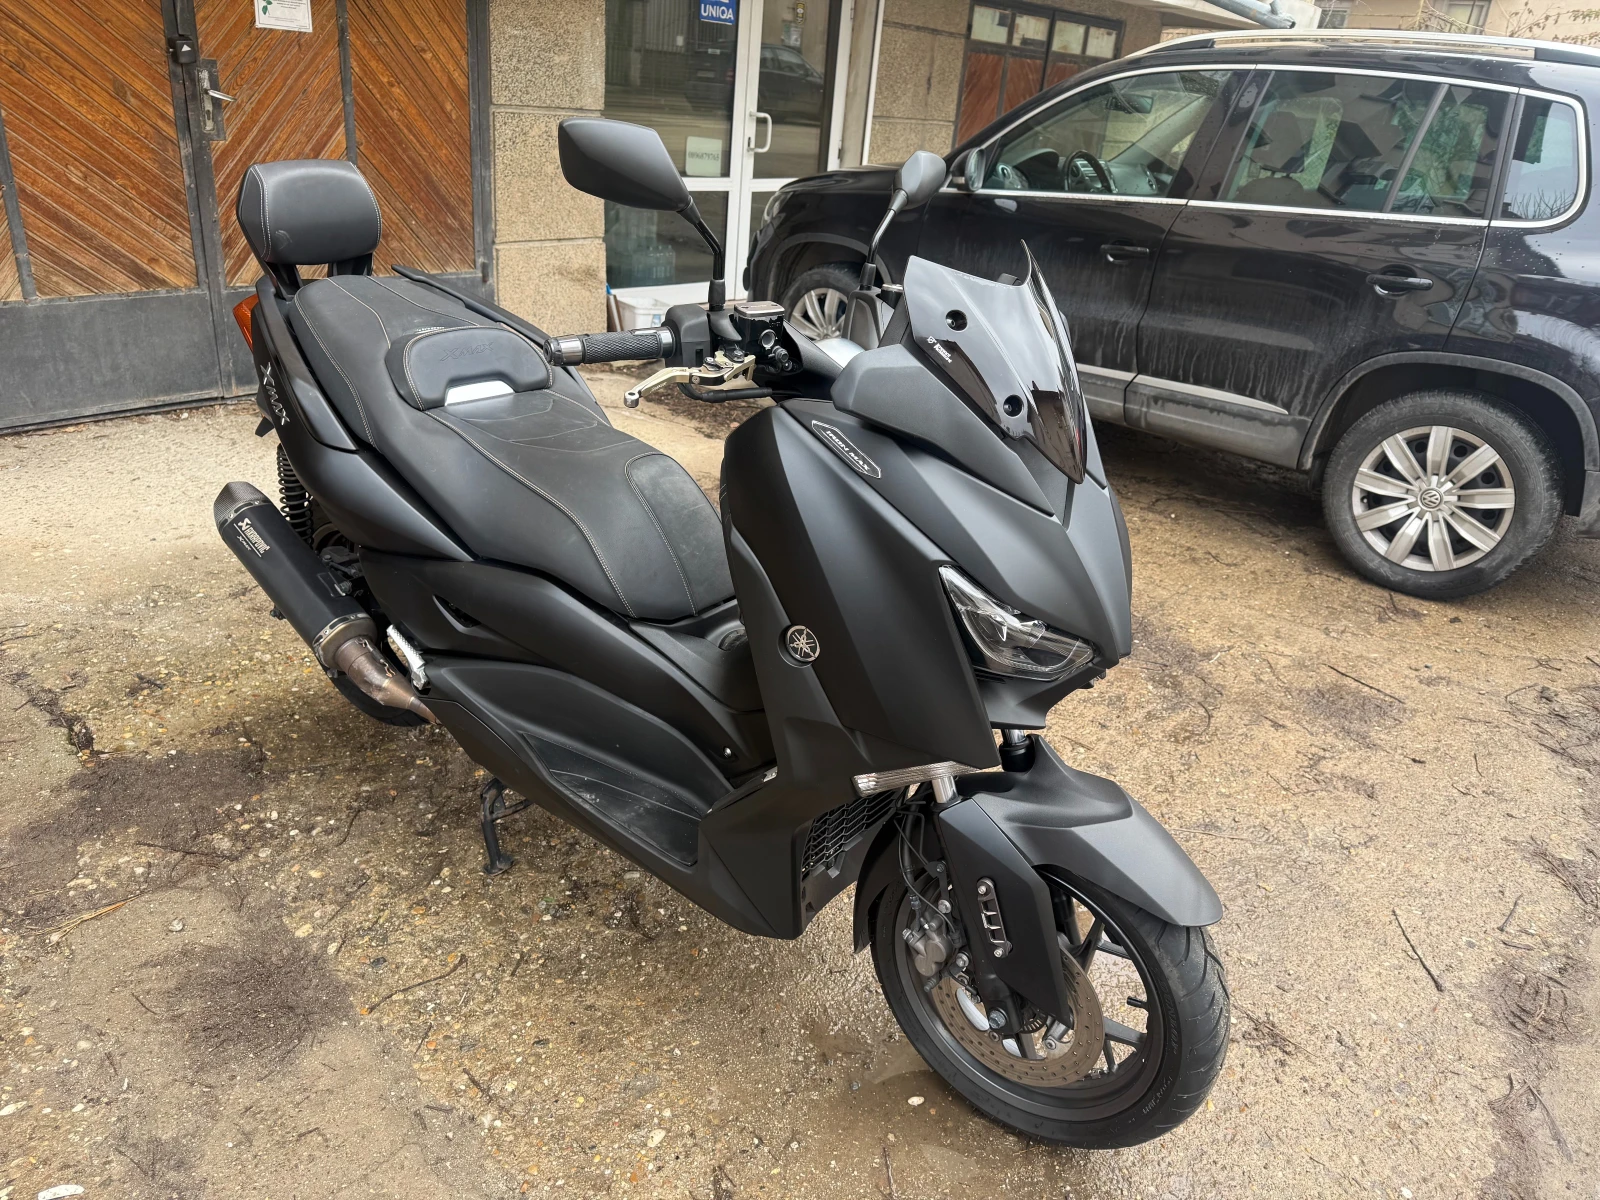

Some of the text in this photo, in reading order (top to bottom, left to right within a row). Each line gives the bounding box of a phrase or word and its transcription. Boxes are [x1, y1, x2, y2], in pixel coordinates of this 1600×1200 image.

[701, 3, 734, 20] UNIQA
[825, 430, 870, 471] IRON MAX
